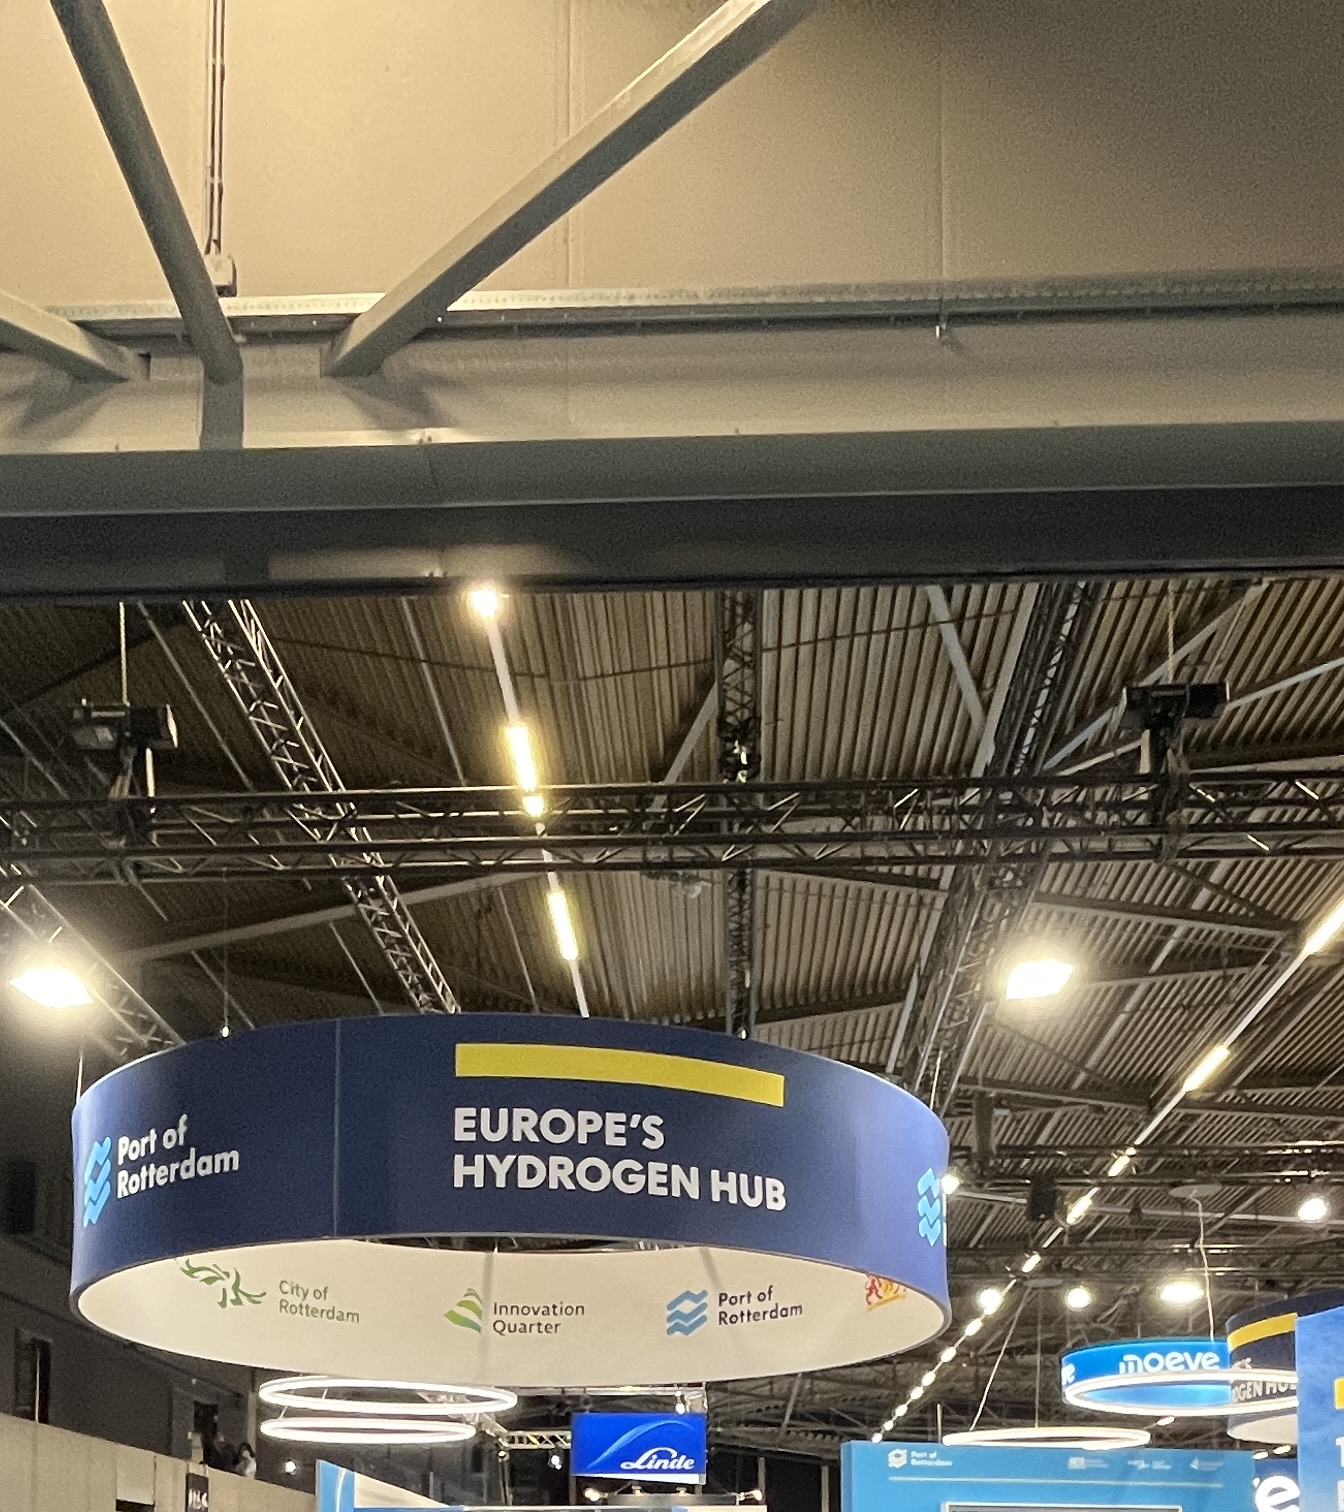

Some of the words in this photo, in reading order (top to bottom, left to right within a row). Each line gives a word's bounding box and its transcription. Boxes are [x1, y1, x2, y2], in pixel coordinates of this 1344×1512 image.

[117, 1128, 157, 1166] Port
[163, 1113, 188, 1149] of
[453, 1107, 665, 1150] EUROPE'S
[116, 1147, 240, 1199] Rotterdam
[453, 1154, 700, 1200] HYDROGEN
[710, 1169, 787, 1211] HUB
[278, 1280, 309, 1300] City
[313, 1286, 328, 1300] of
[718, 1290, 752, 1307] Port
[757, 1284, 774, 1303] of
[278, 1299, 360, 1323] Rotterdam
[493, 1301, 585, 1317] Innovation
[718, 1303, 803, 1326] Rotterdam
[492, 1320, 561, 1336] Quarter
[1119, 1351, 1220, 1374] moeve
[620, 1447, 696, 1471] Linde
